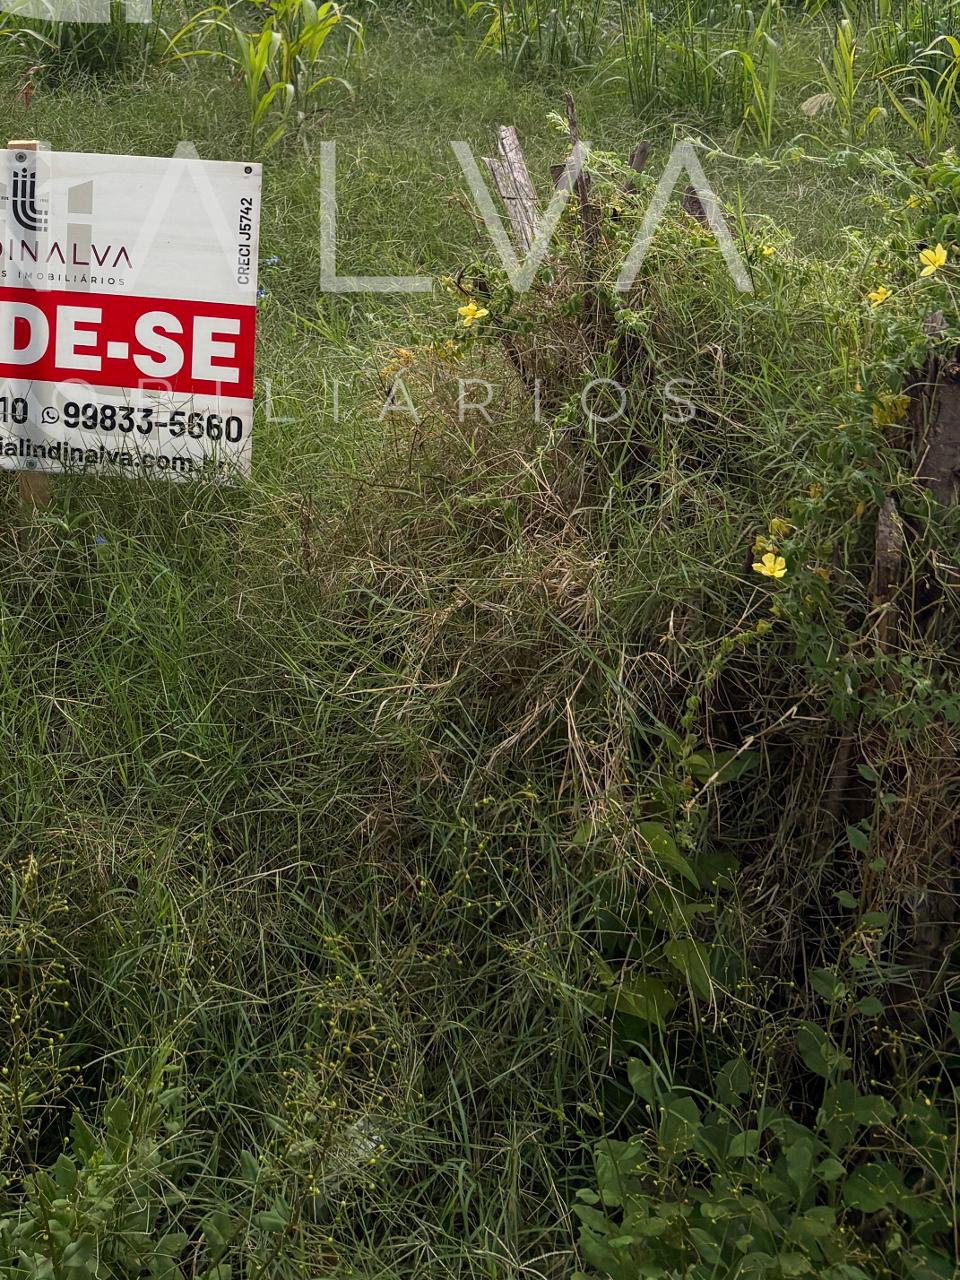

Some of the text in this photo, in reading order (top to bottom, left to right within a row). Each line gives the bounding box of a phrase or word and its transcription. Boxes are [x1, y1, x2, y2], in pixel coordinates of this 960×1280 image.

[237, 197, 253, 285] CRECI J5742
[17, 271, 126, 286] IMOBILIÁRIOS
[63, 401, 243, 443] 99833-5660
